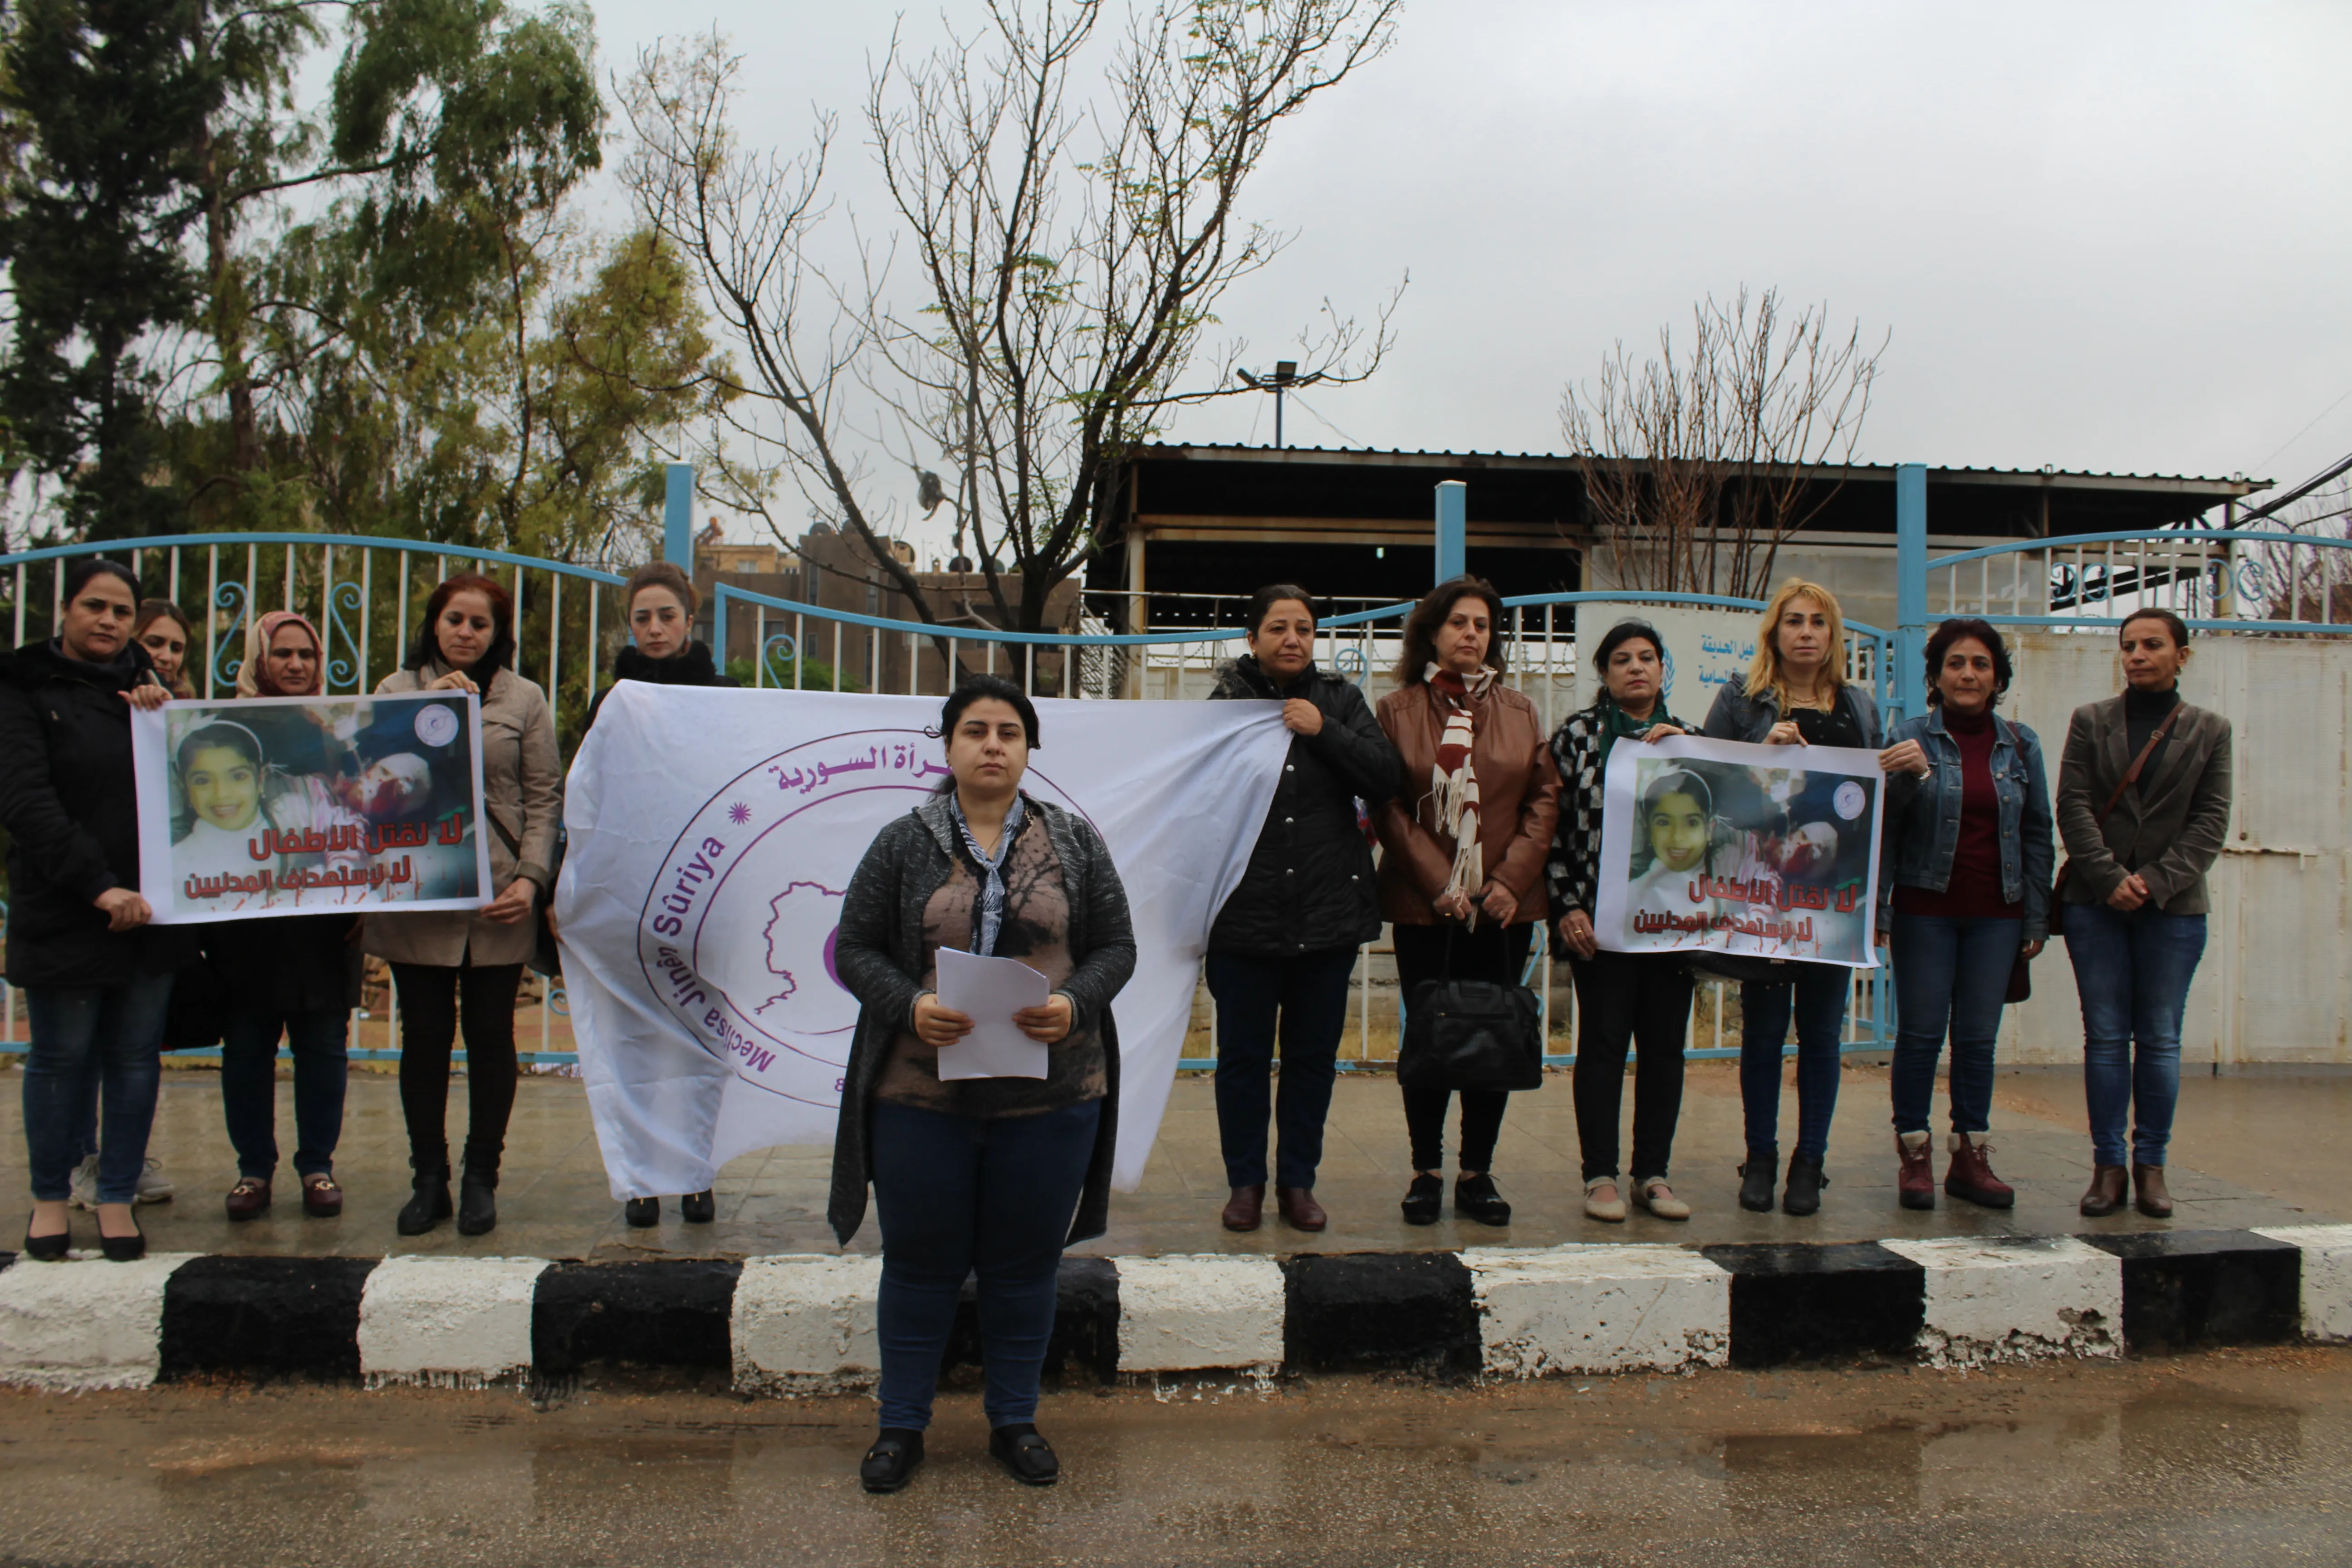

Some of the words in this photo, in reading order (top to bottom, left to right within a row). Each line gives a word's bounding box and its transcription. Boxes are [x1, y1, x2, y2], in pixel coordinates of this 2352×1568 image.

[768, 745, 887, 794] السورية
[364, 822, 429, 855] لقتل
[437, 813, 463, 846] لا
[184, 869, 273, 900] المدنيين
[390, 855, 411, 883] لا
[653, 837, 726, 937] Sûriya
[1777, 884, 1828, 912] لقتل
[1834, 883, 1857, 912] لا
[1634, 909, 1708, 934] المدنيين
[1797, 916, 1813, 941] لا
[704, 1007, 776, 1073] Meclisa
